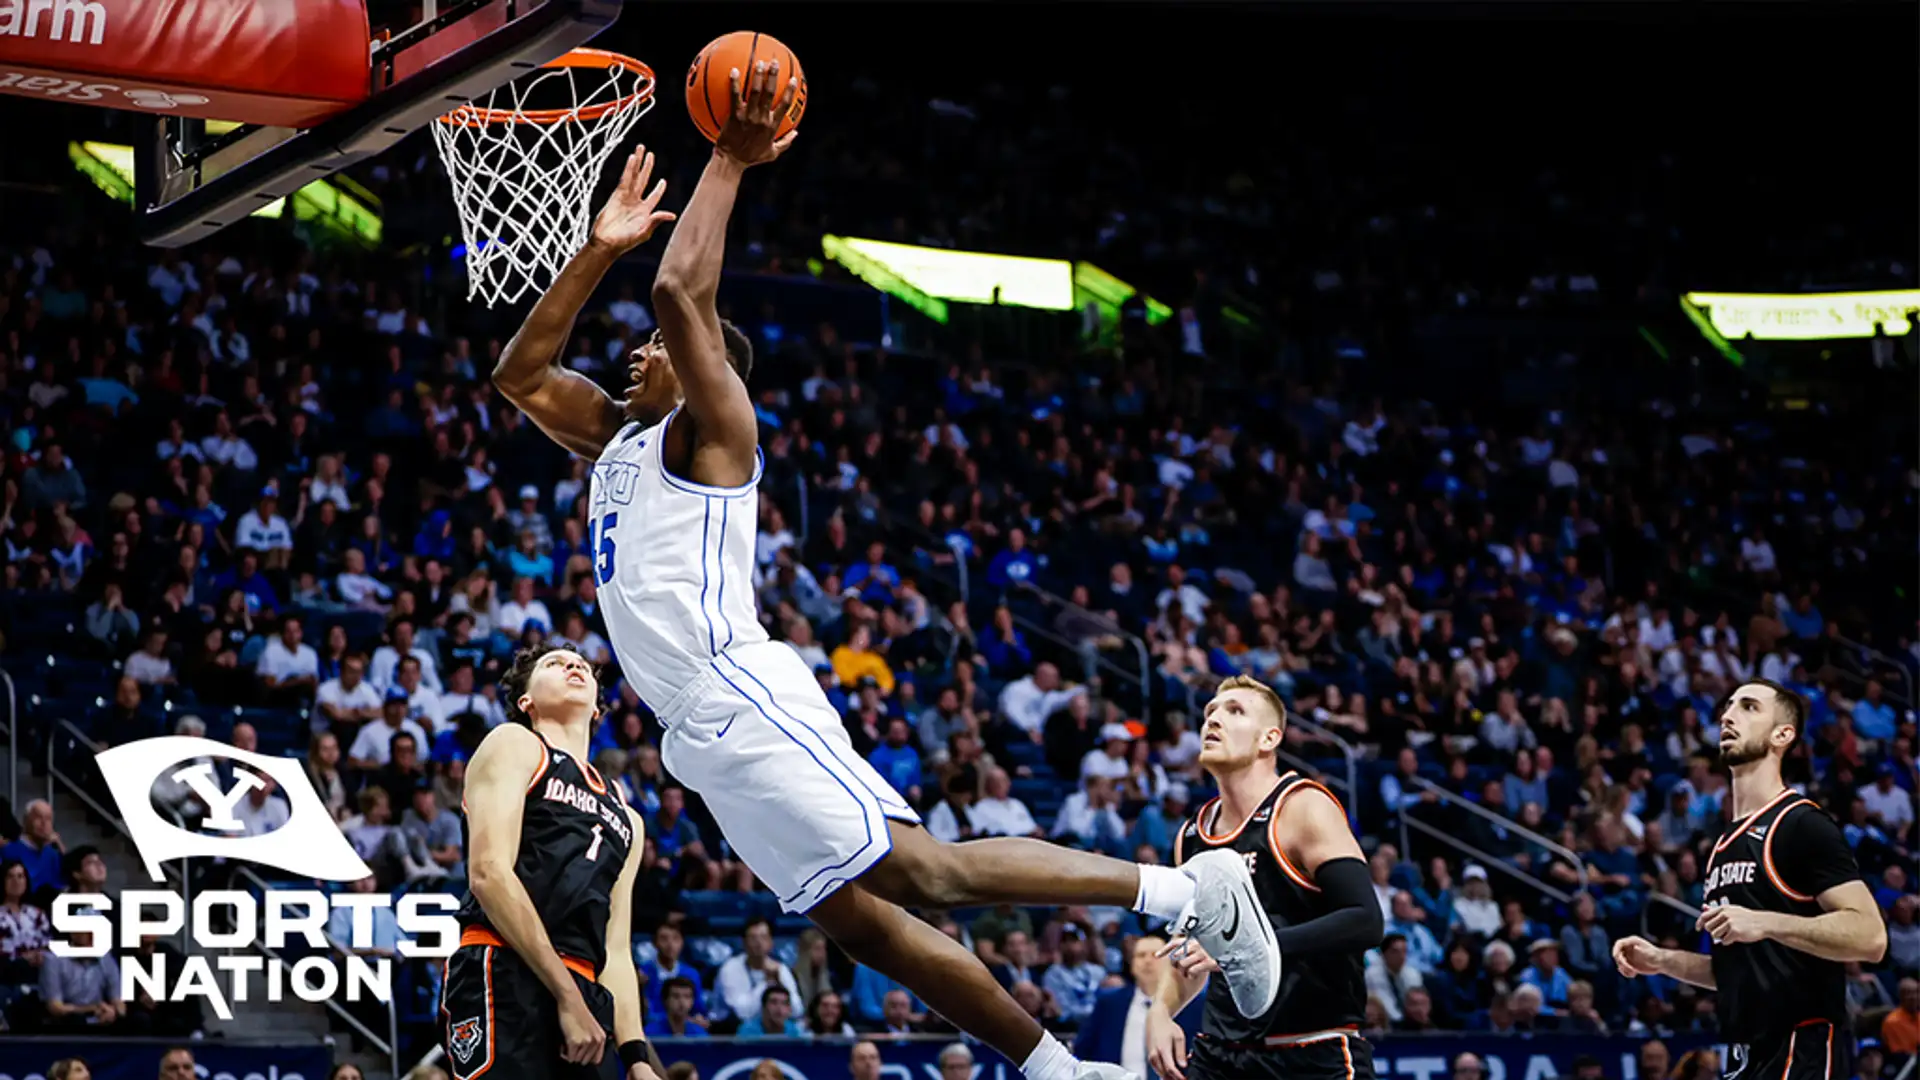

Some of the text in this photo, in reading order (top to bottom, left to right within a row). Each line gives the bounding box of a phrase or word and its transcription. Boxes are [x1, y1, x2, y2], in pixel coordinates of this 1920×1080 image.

[543, 777, 598, 814] IDAHO
[585, 823, 604, 862] 1
[1719, 861, 1757, 888] STATE
